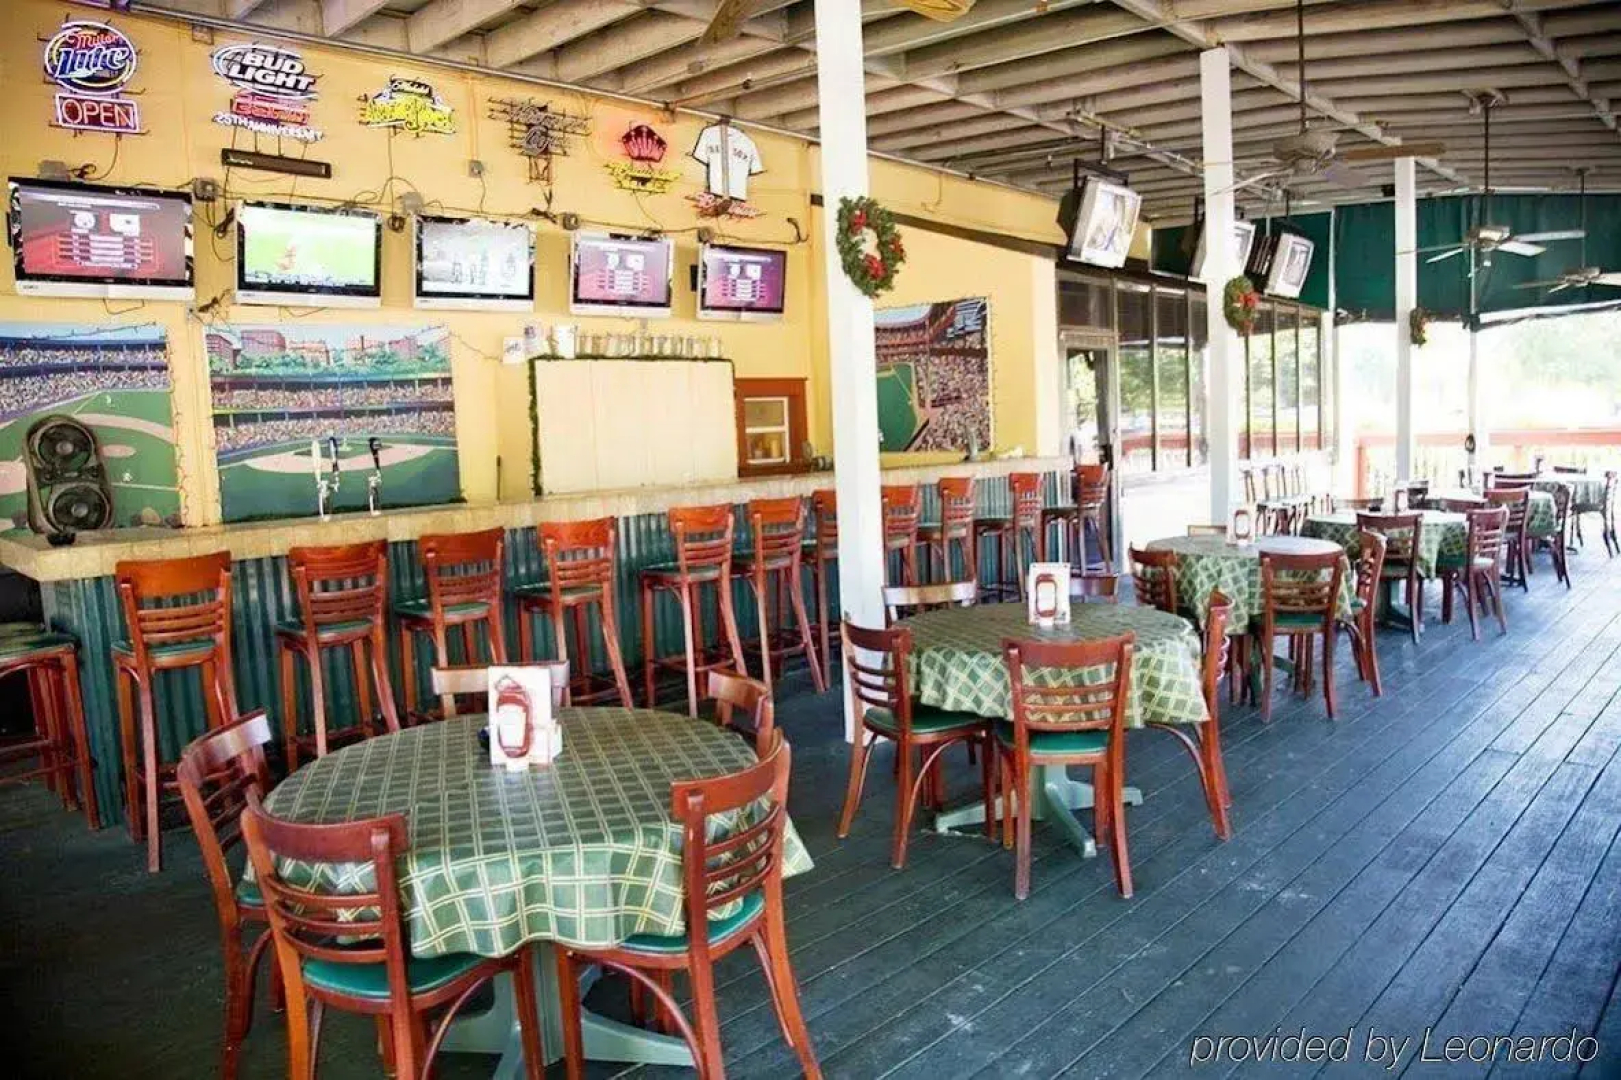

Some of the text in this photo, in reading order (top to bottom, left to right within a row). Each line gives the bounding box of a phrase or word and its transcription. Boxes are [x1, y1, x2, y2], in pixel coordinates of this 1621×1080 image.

[54, 45, 130, 78] Lite
[240, 51, 304, 75] BUD
[226, 63, 317, 91] LIGHT
[61, 98, 135, 128] OPEN
